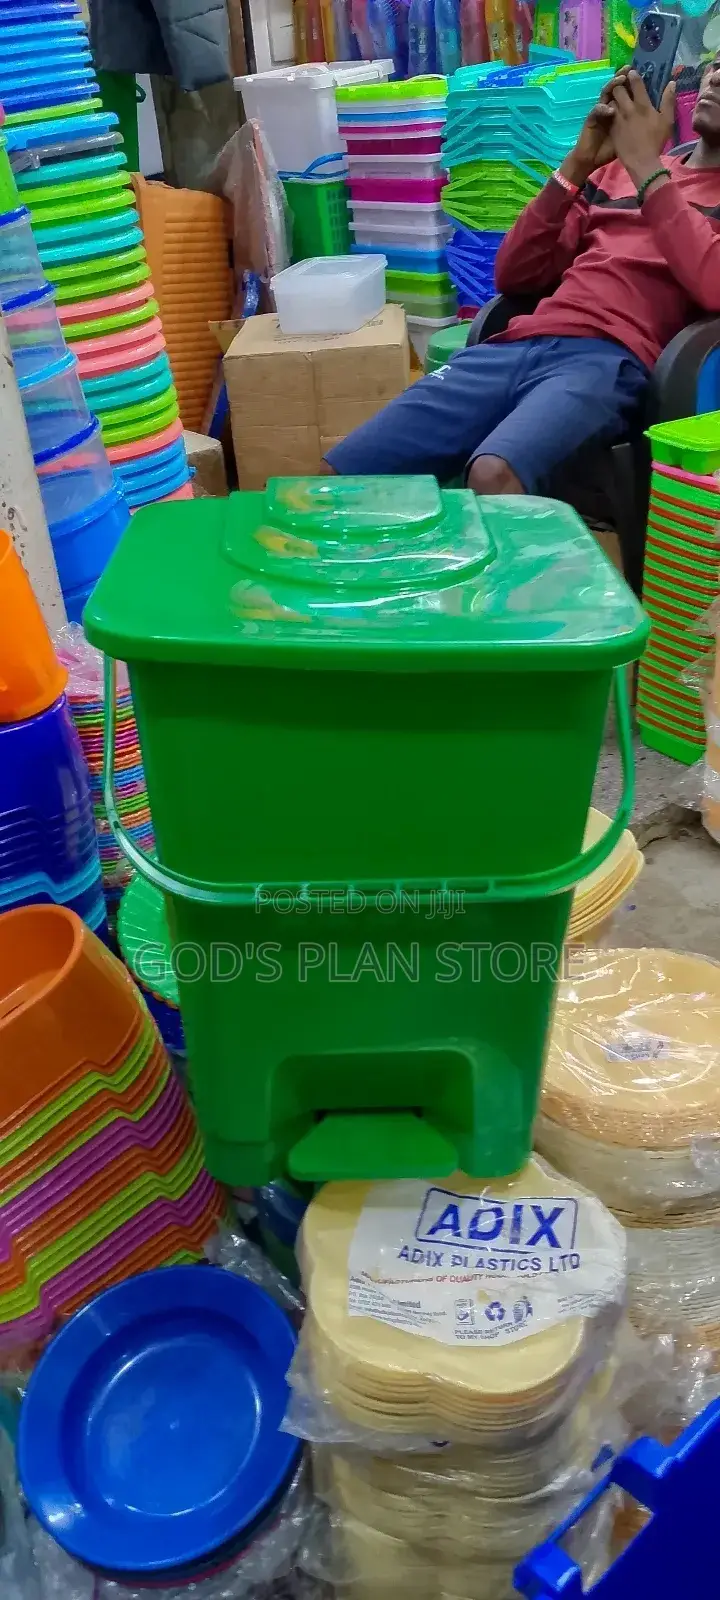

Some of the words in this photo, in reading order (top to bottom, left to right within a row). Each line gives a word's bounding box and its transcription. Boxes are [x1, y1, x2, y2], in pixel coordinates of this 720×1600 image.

[426, 1203, 565, 1248] ADIX
[397, 1245, 445, 1267] ADIX
[450, 1254, 542, 1272] PLASTICS
[548, 1253, 581, 1273] LTD
[436, 1275, 447, 1283] OF
